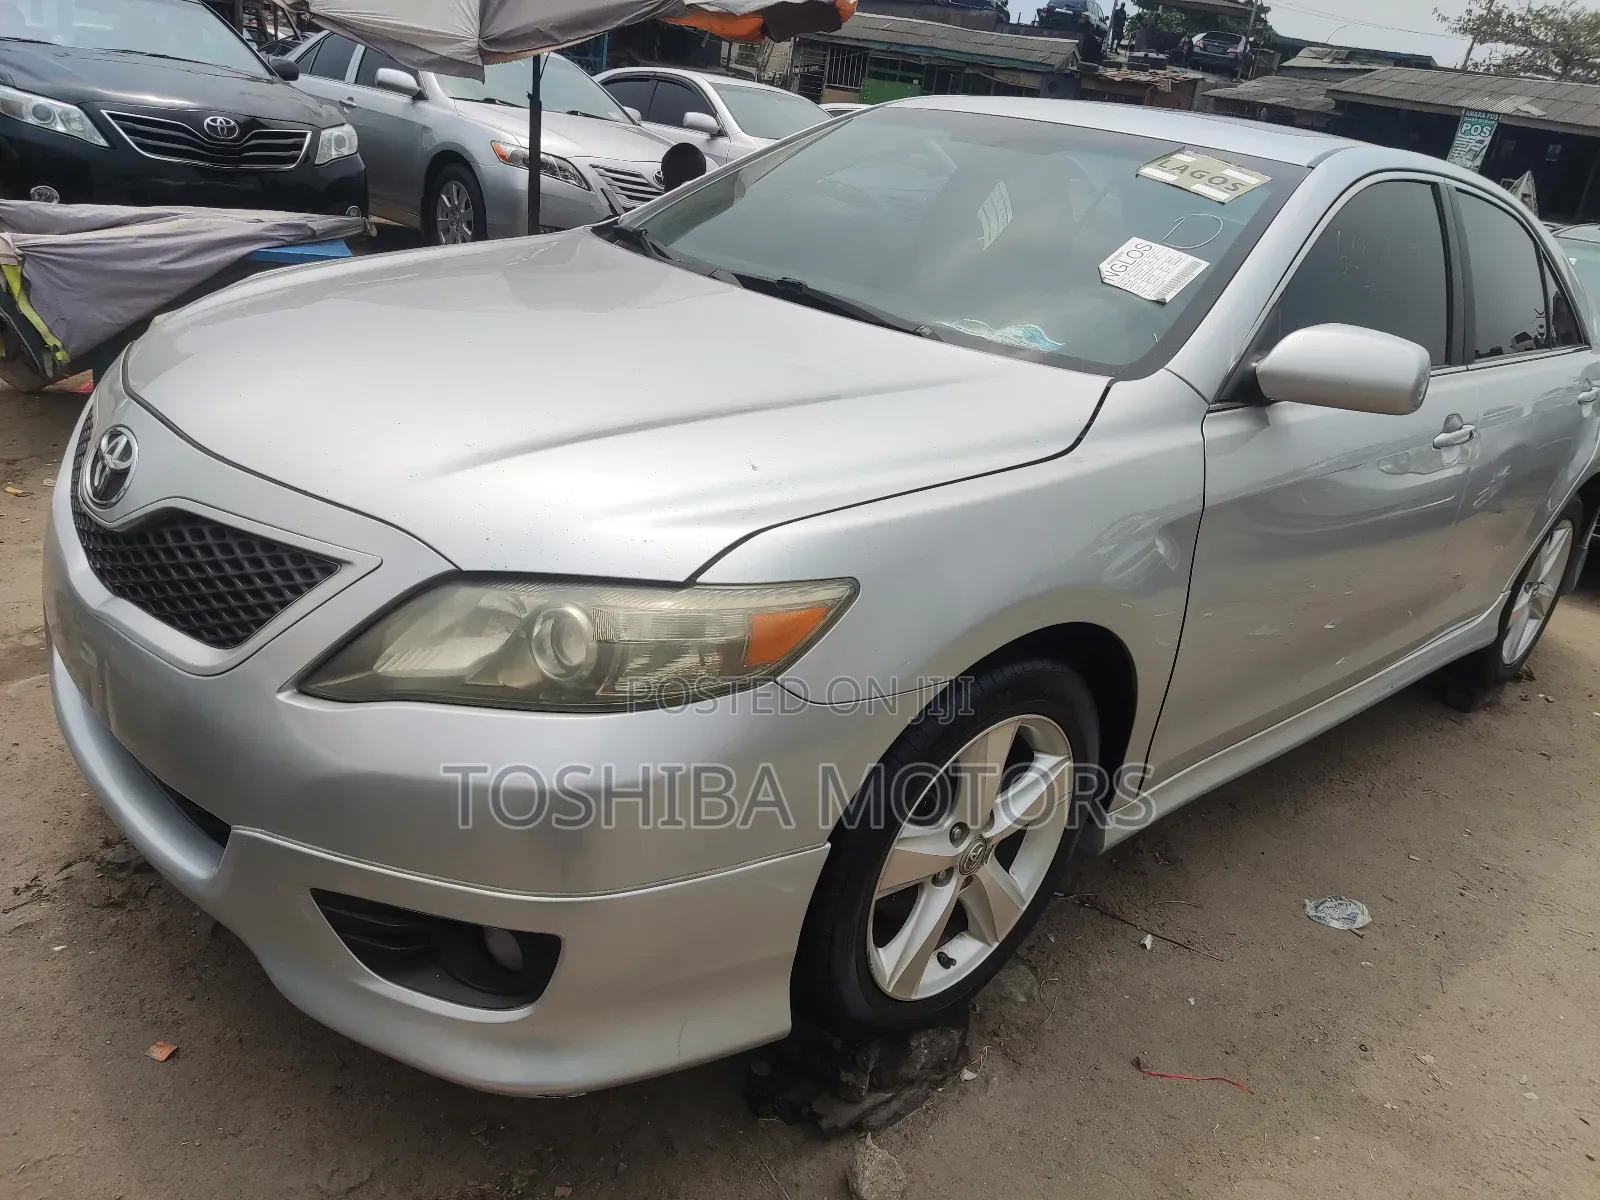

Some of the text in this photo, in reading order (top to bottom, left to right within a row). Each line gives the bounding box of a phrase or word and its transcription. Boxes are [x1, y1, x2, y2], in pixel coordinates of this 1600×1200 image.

[1486, 113, 1499, 121] POS
[1461, 122, 1492, 137] POS
[1157, 159, 1247, 192] LAGOS
